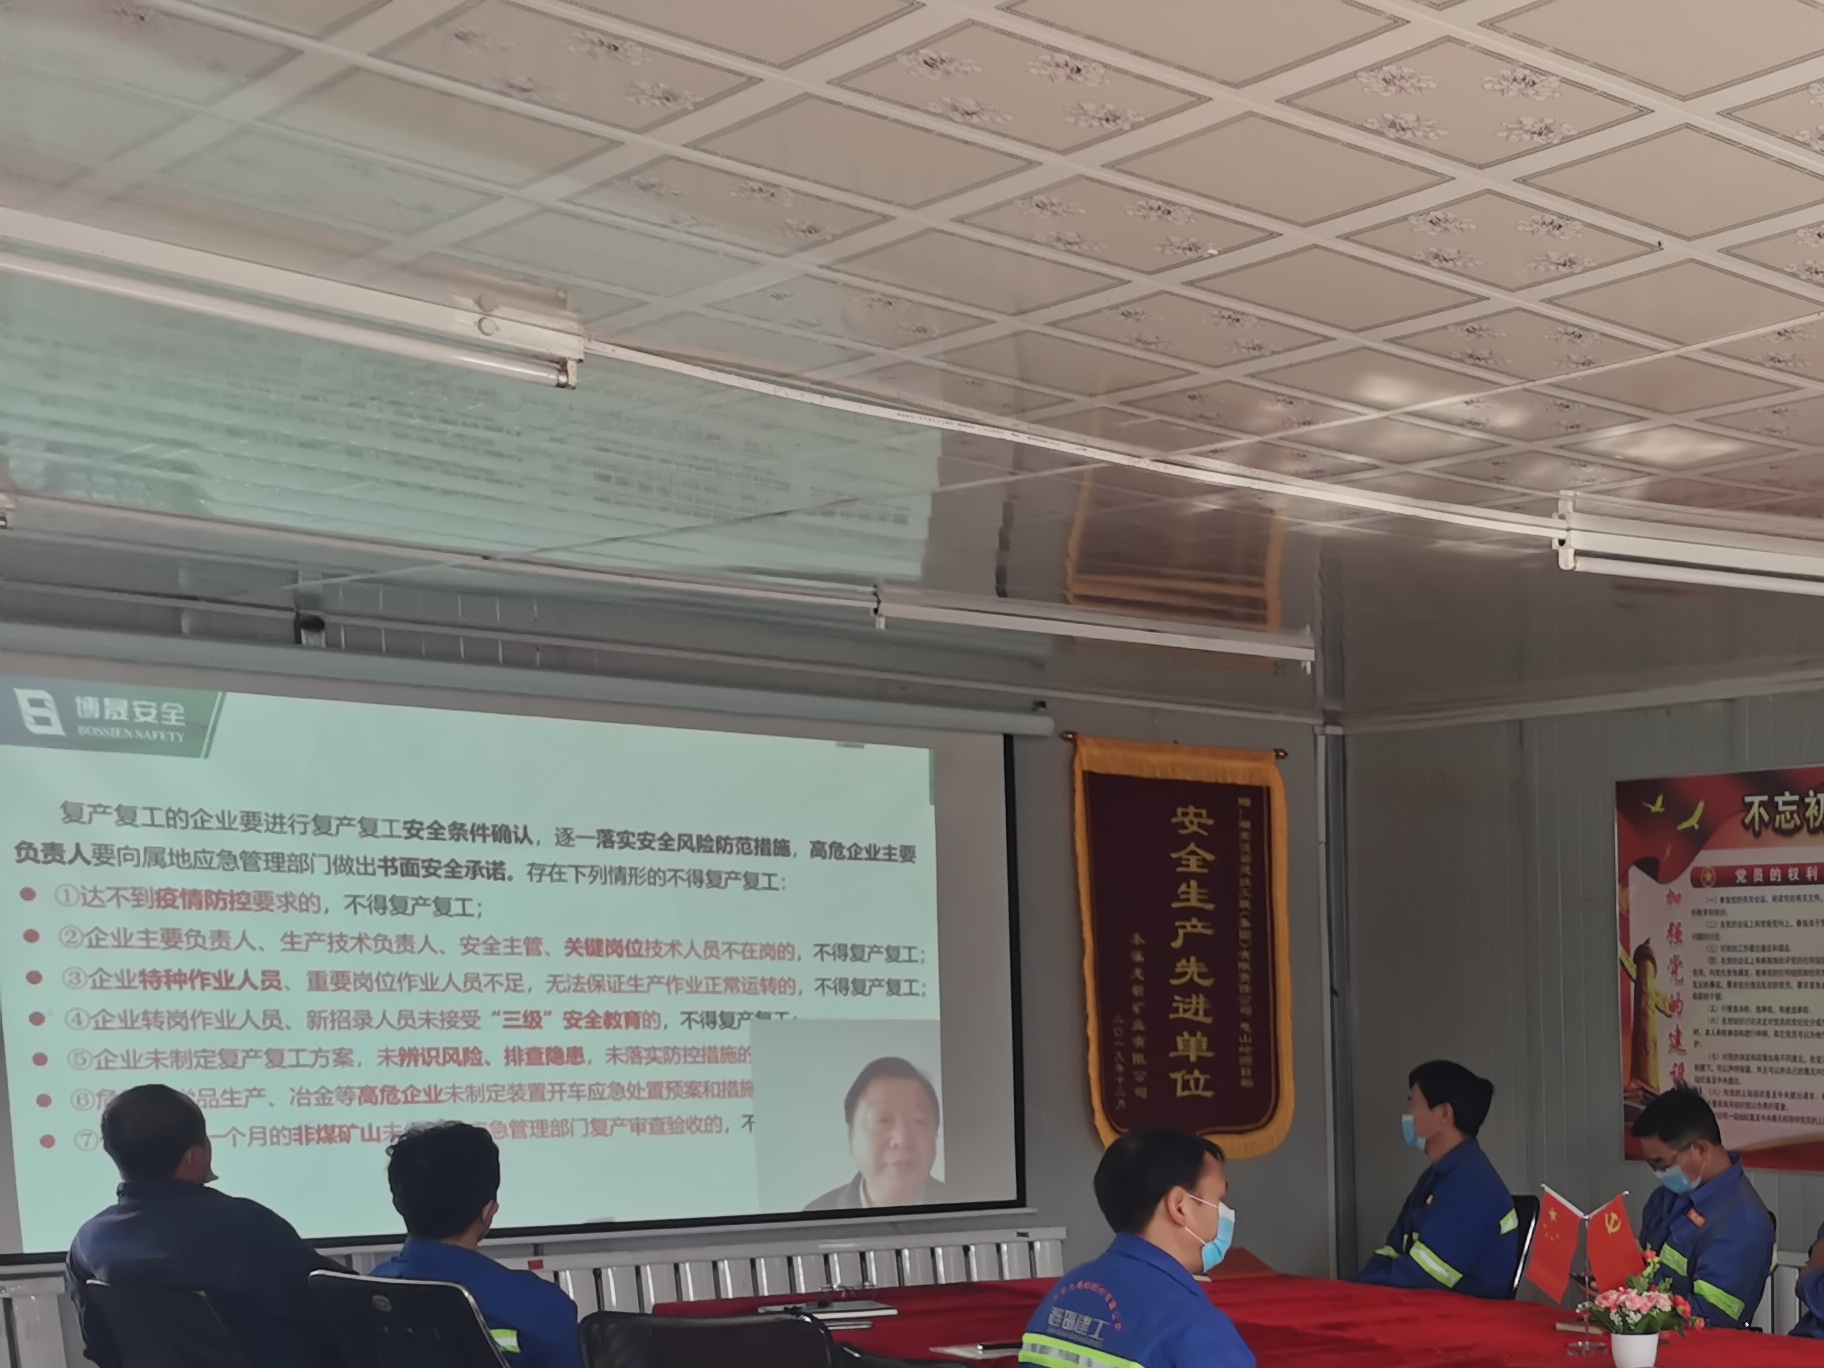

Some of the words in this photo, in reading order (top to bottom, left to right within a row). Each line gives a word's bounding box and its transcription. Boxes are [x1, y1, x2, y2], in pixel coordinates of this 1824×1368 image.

[1169, 803, 1216, 1098] 安全生产先进单位
[1734, 867, 1819, 884] 党员的权利
